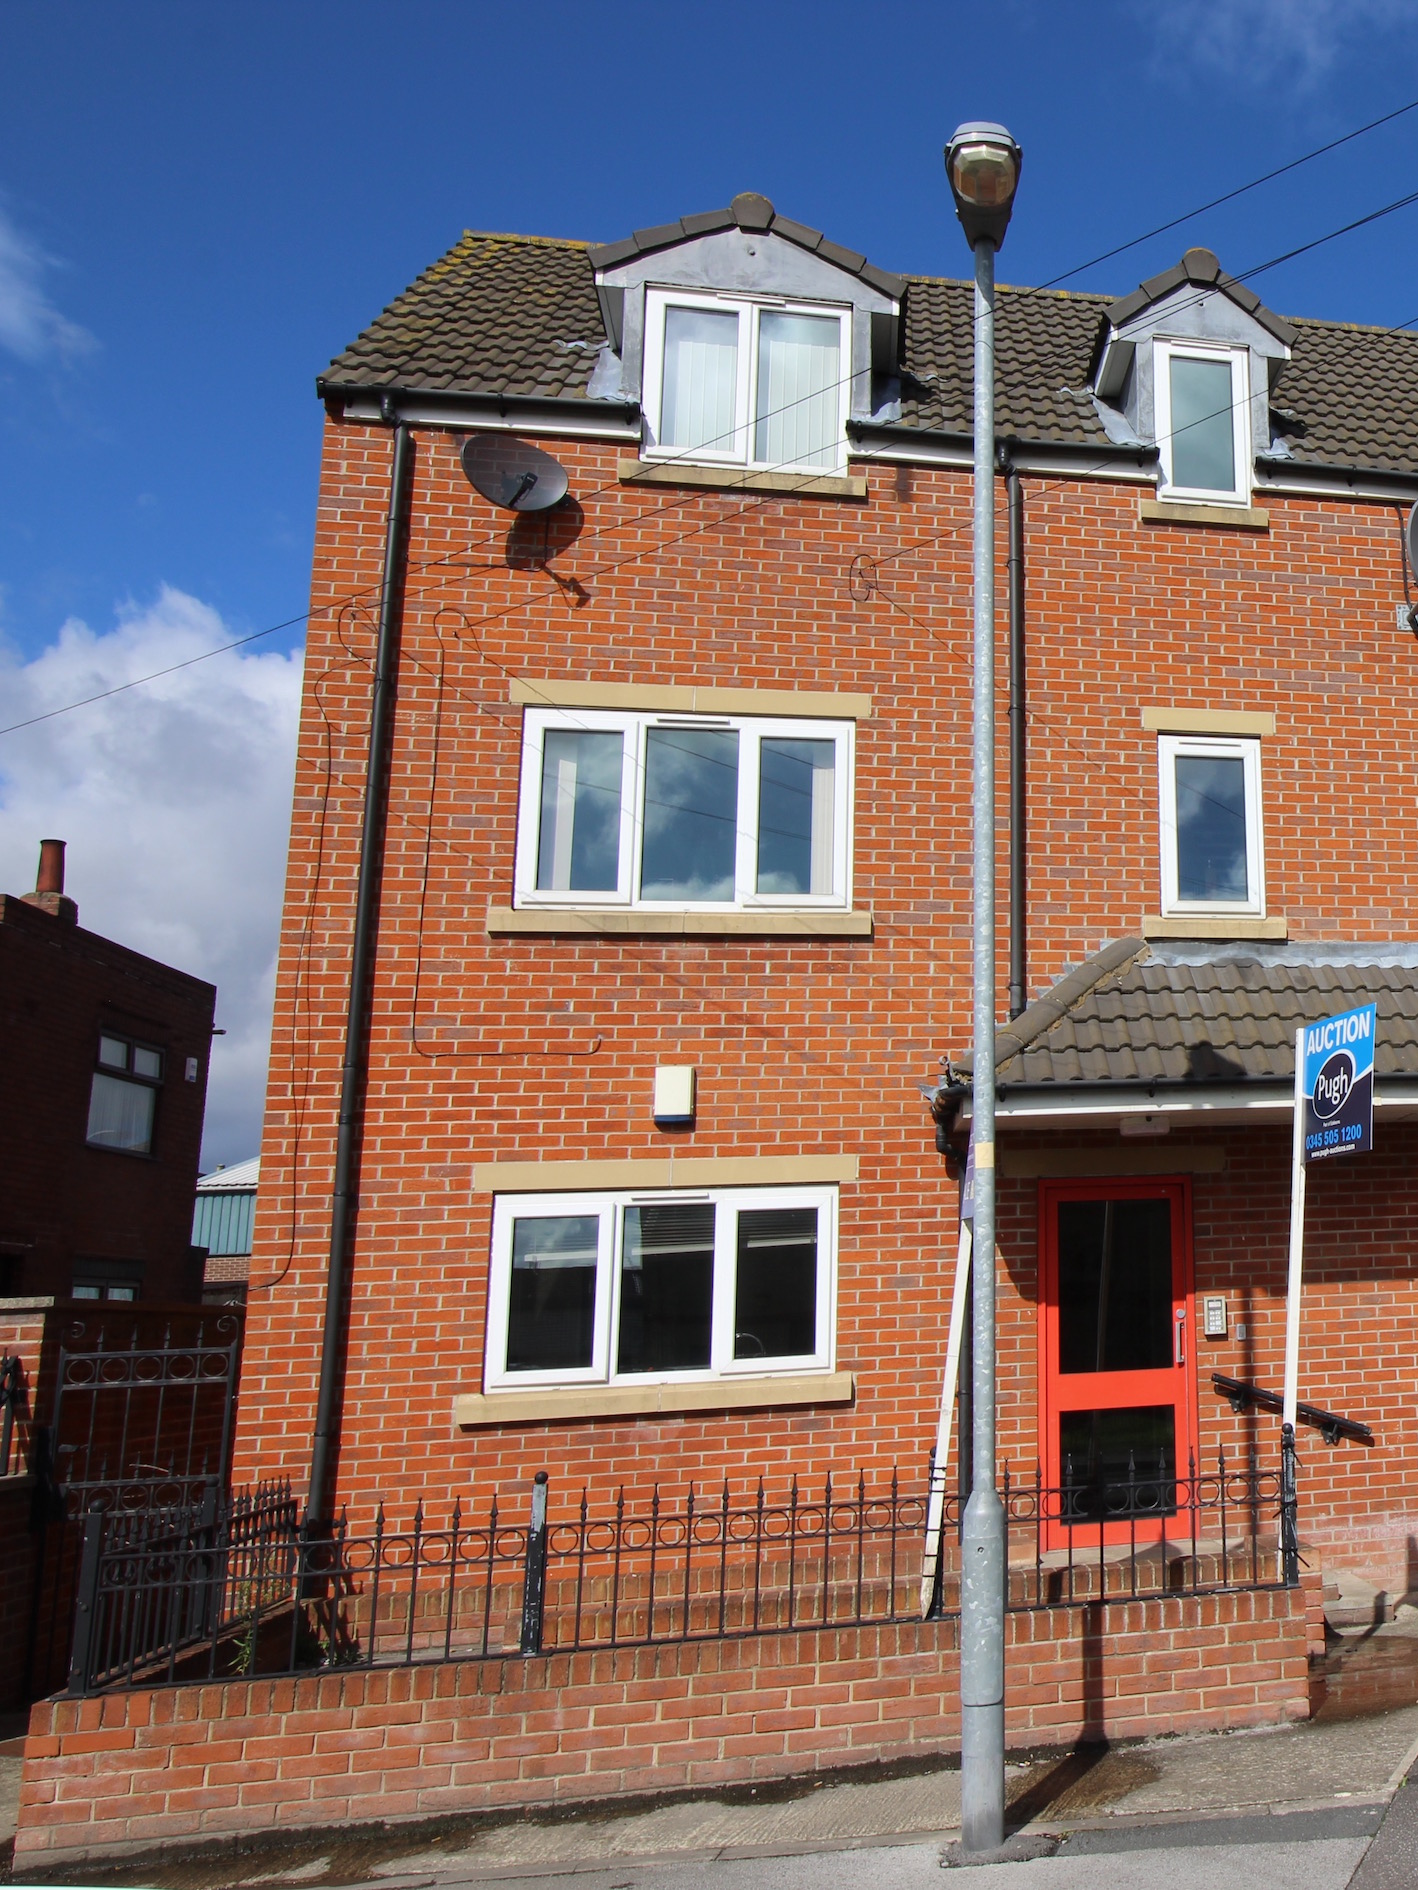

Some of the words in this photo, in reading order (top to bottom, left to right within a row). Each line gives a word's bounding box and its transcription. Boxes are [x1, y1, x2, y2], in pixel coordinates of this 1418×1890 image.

[1306, 1011, 1371, 1056] AUCTION
[1318, 1066, 1348, 1105] Pugh
[1305, 1132, 1323, 1150] 0345
[1324, 1129, 1339, 1146] 505
[1341, 1124, 1362, 1142] 1200
